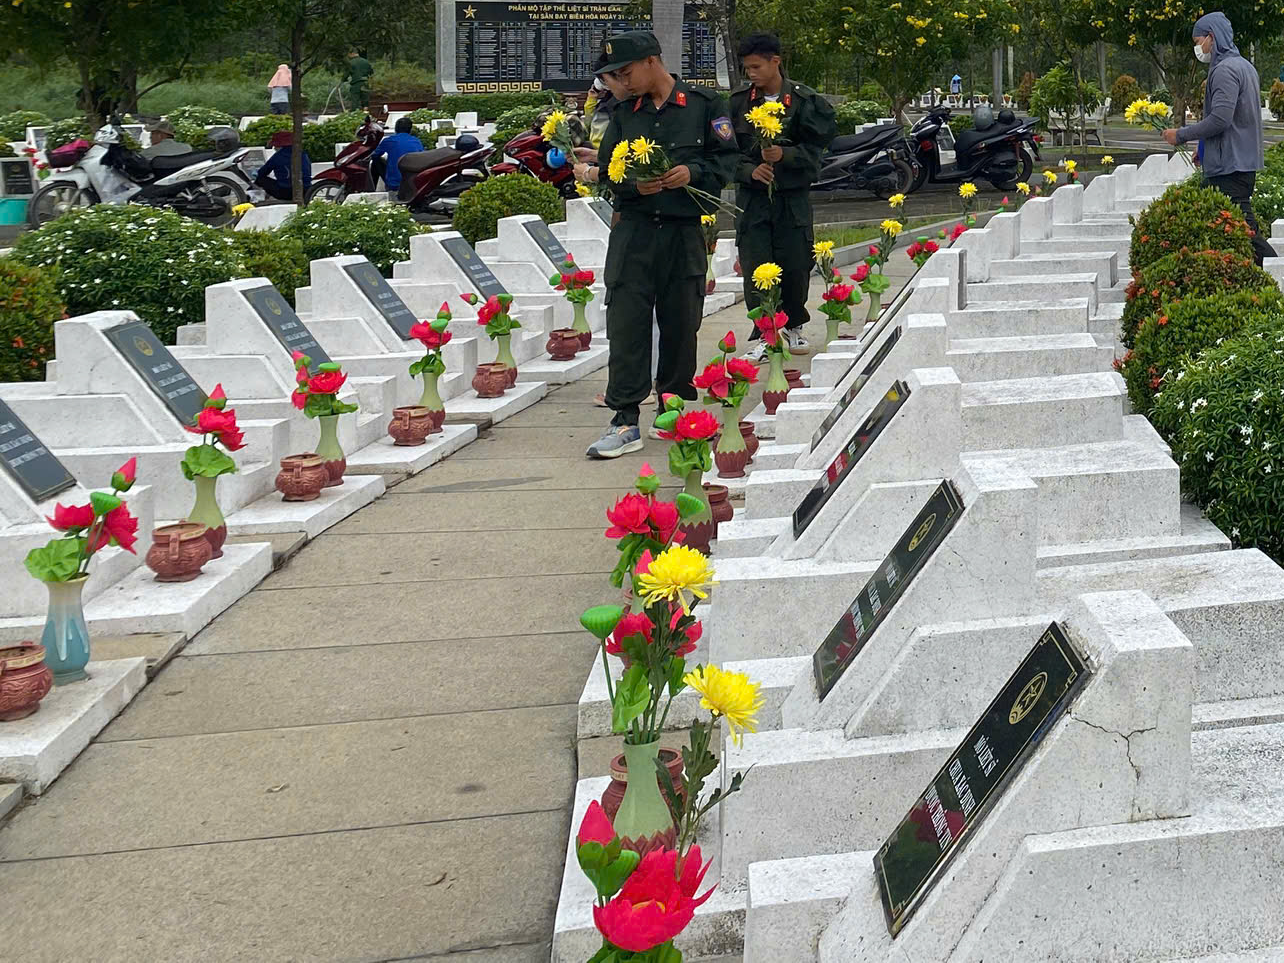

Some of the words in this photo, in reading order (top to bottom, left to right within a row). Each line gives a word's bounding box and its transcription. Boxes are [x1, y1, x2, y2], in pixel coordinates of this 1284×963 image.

[528, 4, 538, 12] MỘ
[974, 735, 989, 757] MỘ
[978, 745, 994, 770] LIỆT
[984, 759, 999, 777] SĨ
[955, 774, 971, 798] XÁC
[938, 828, 952, 851] TIN
